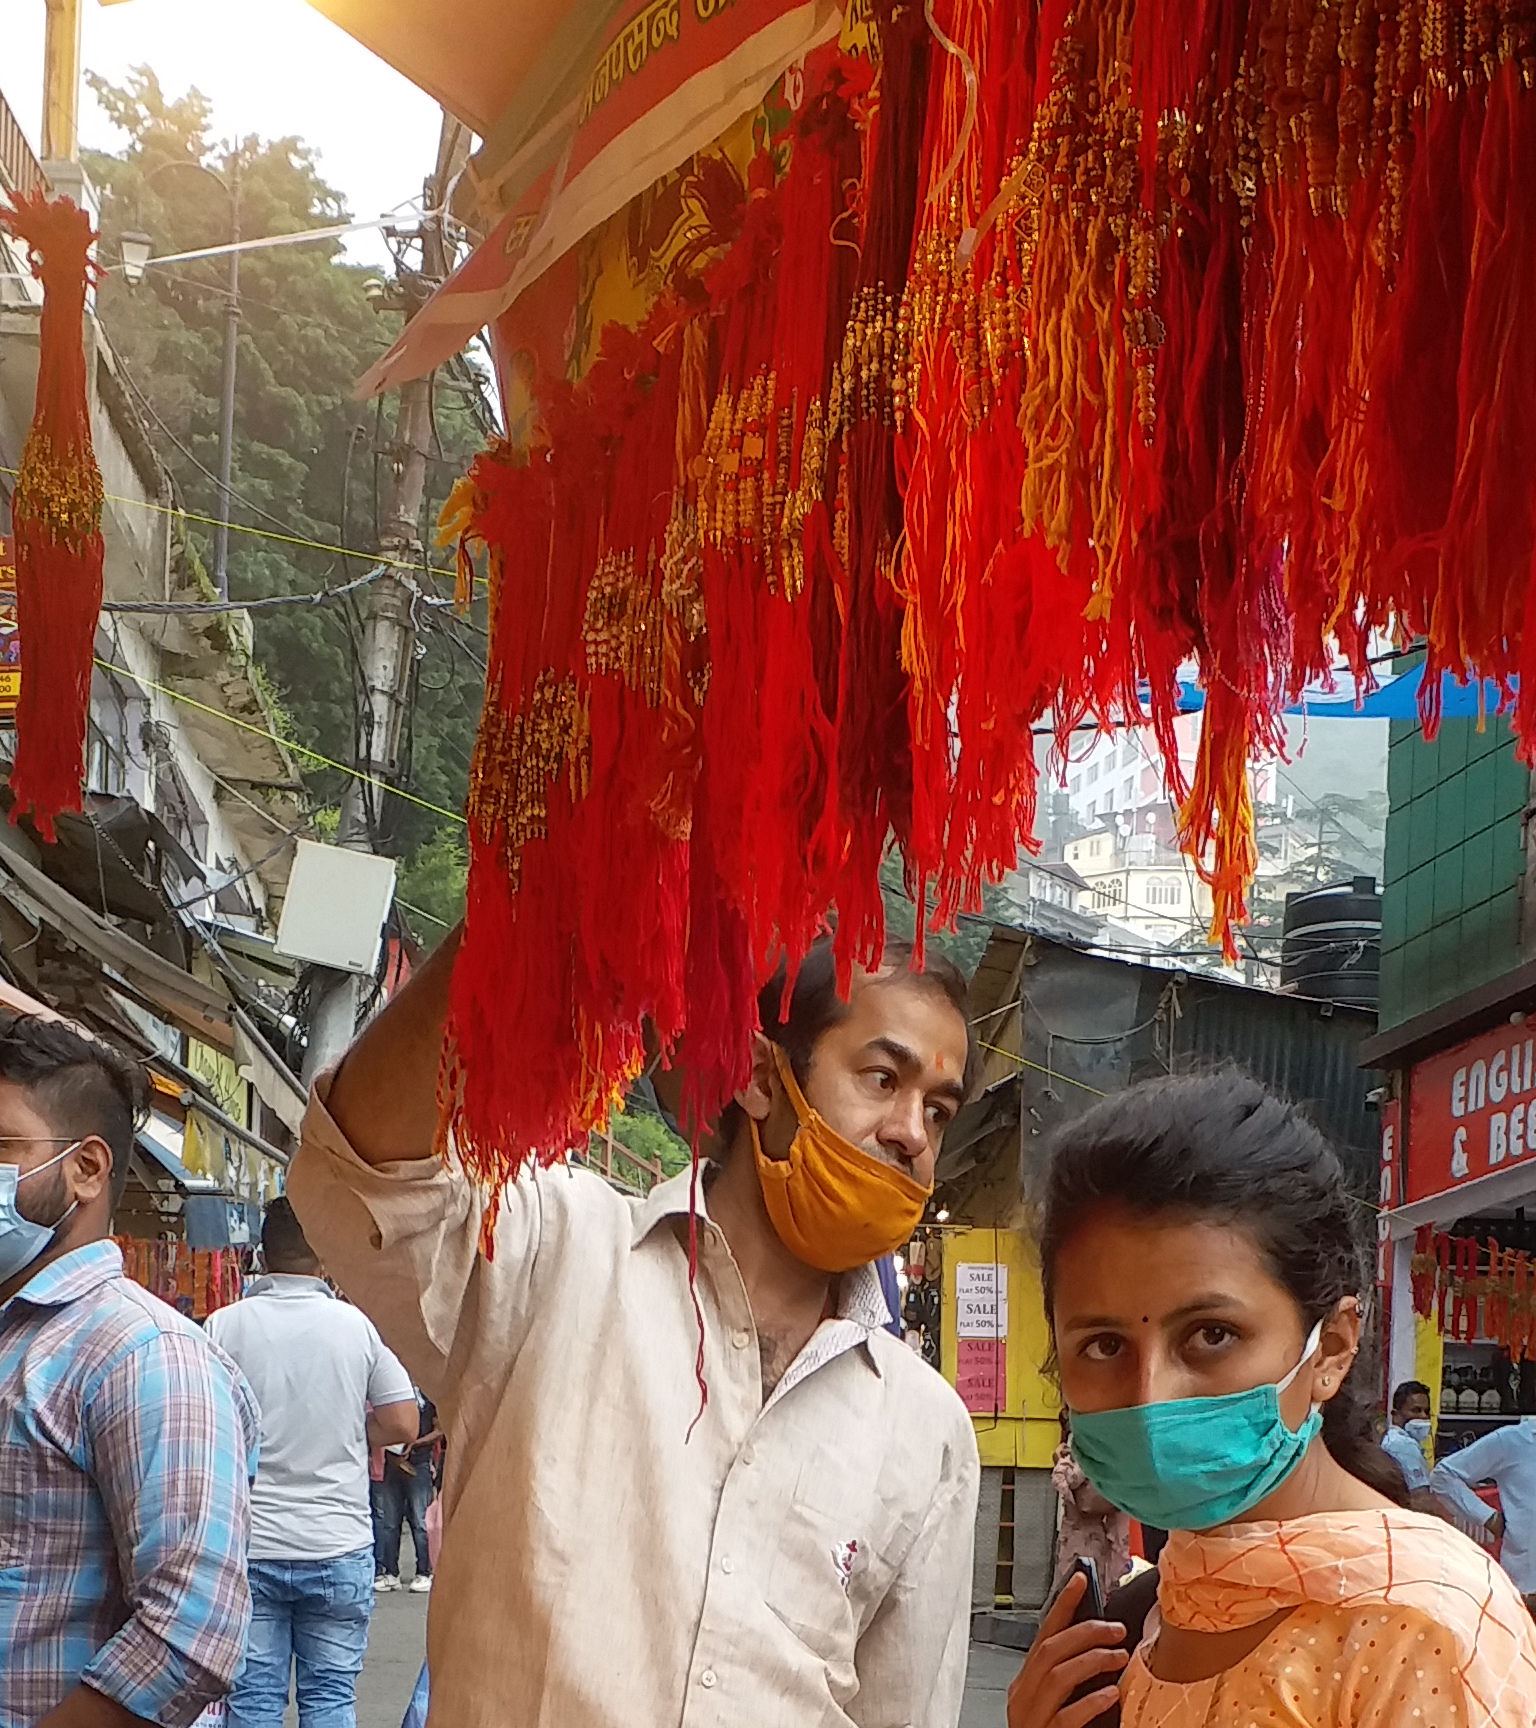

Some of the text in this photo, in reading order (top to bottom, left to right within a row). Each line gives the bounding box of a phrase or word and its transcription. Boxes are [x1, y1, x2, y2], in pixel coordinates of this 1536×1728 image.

[1451, 1125, 1469, 1179] &
[969, 1273, 994, 1282] SALE
[975, 1286, 994, 1295] 50%
[966, 1304, 998, 1315] SALE
[975, 1319, 995, 1328] 50%
[967, 1343, 995, 1352] SALE
[967, 1378, 995, 1388] SALE
